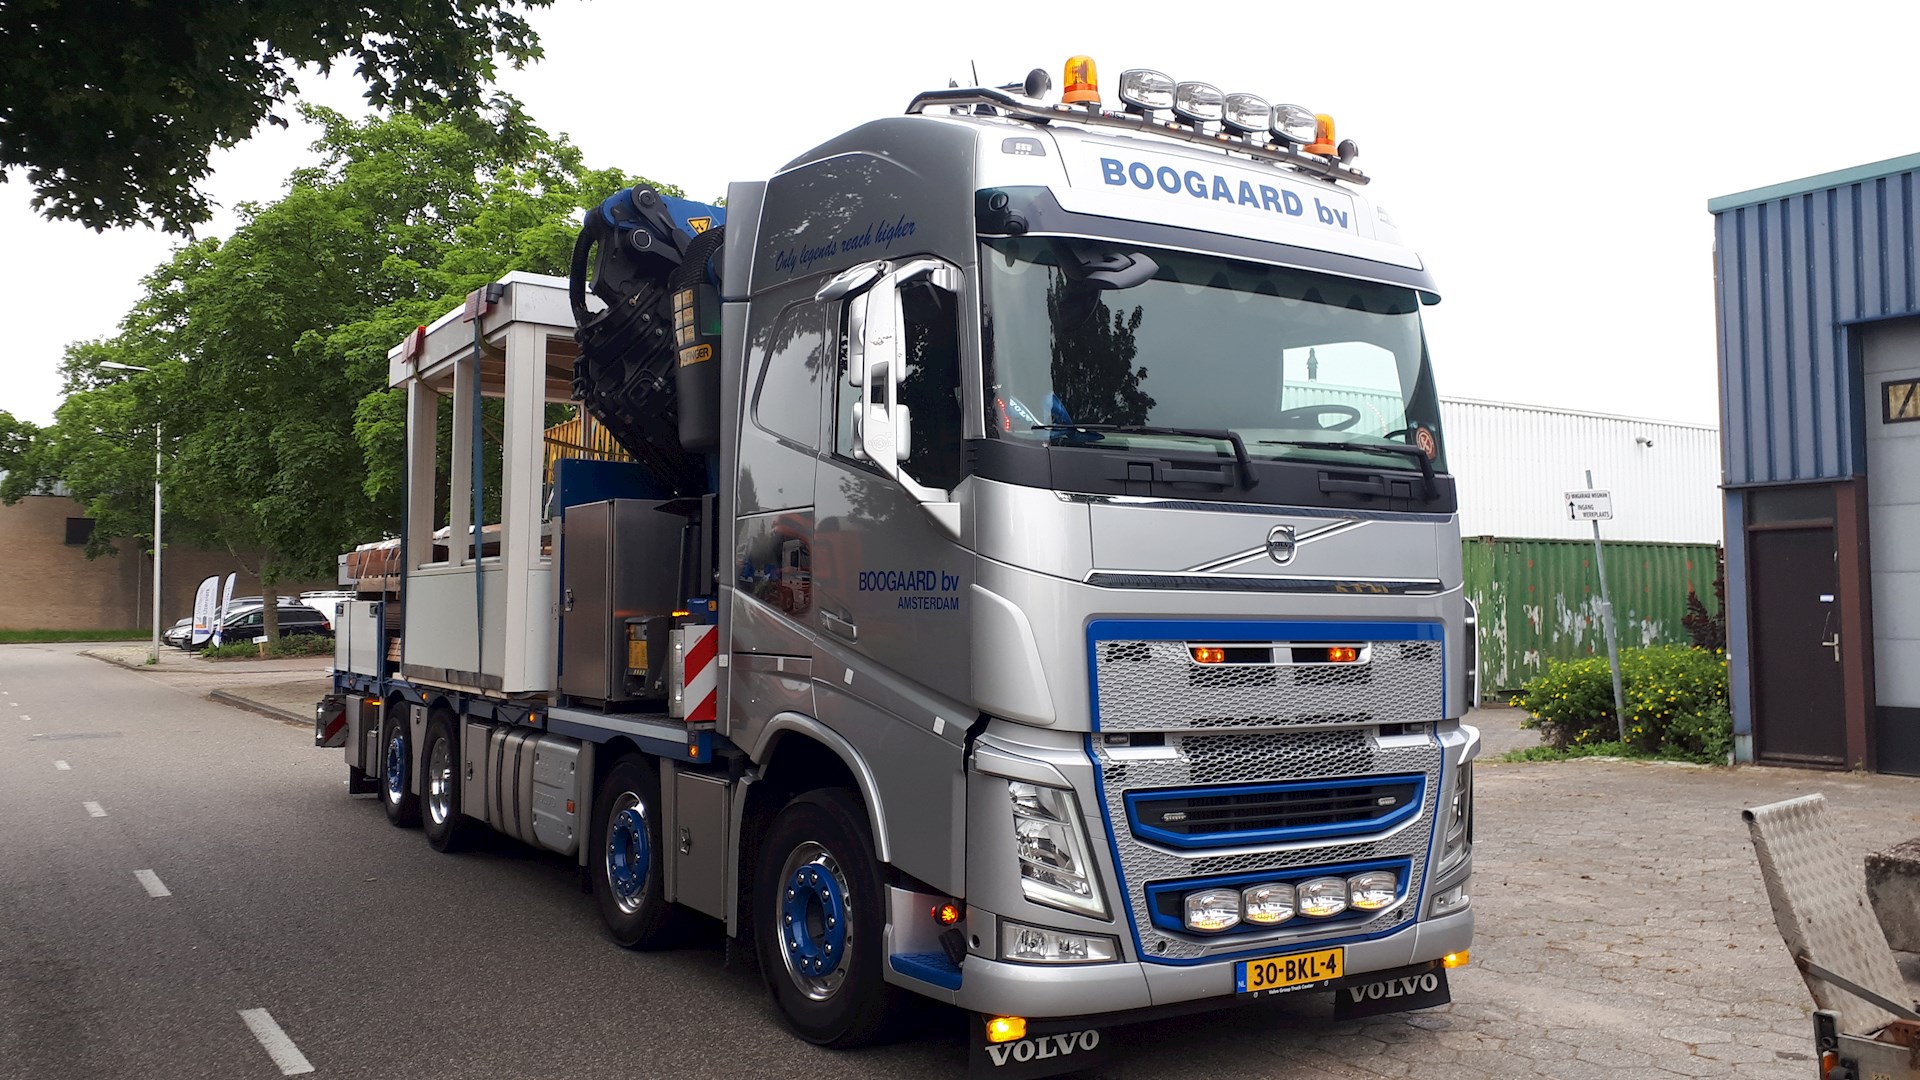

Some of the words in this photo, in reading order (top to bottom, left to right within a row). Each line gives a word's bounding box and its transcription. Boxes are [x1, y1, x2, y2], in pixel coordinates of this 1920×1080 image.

[1100, 157, 1303, 217] BOOGAARD
[1314, 197, 1348, 229] bv
[775, 250, 797, 273] Only
[799, 241, 836, 270] legends
[841, 222, 873, 253] reach
[874, 214, 915, 249] higher
[859, 570, 937, 592] BOOGAARD
[941, 570, 960, 592] bv
[897, 596, 959, 610] AMSTERDAM
[1253, 953, 1337, 986] 30-BKL-4
[1347, 973, 1438, 1003] VOLVO
[985, 1029, 1099, 1067] VOLVO
